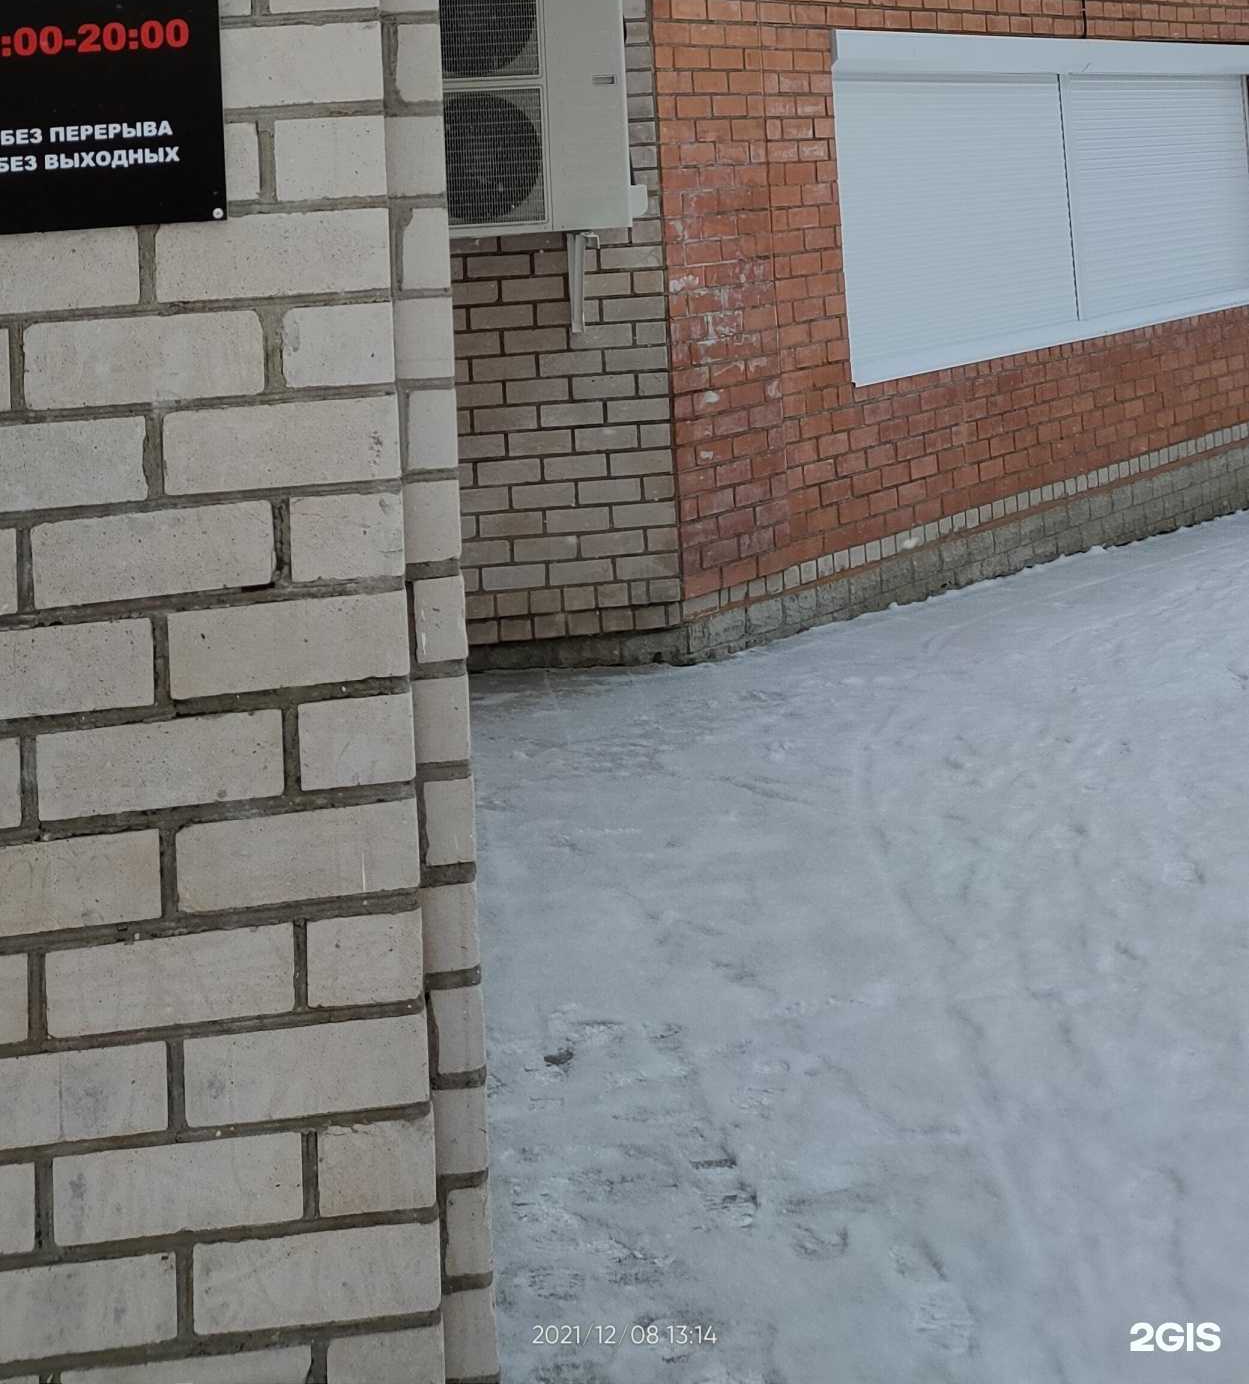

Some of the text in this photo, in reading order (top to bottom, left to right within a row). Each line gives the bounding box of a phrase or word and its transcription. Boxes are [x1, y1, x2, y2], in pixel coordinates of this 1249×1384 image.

[0, 120, 174, 146] БЕЗ ПЕРЕРЫВА
[44, 146, 180, 170] ВЫХОДНЫХ
